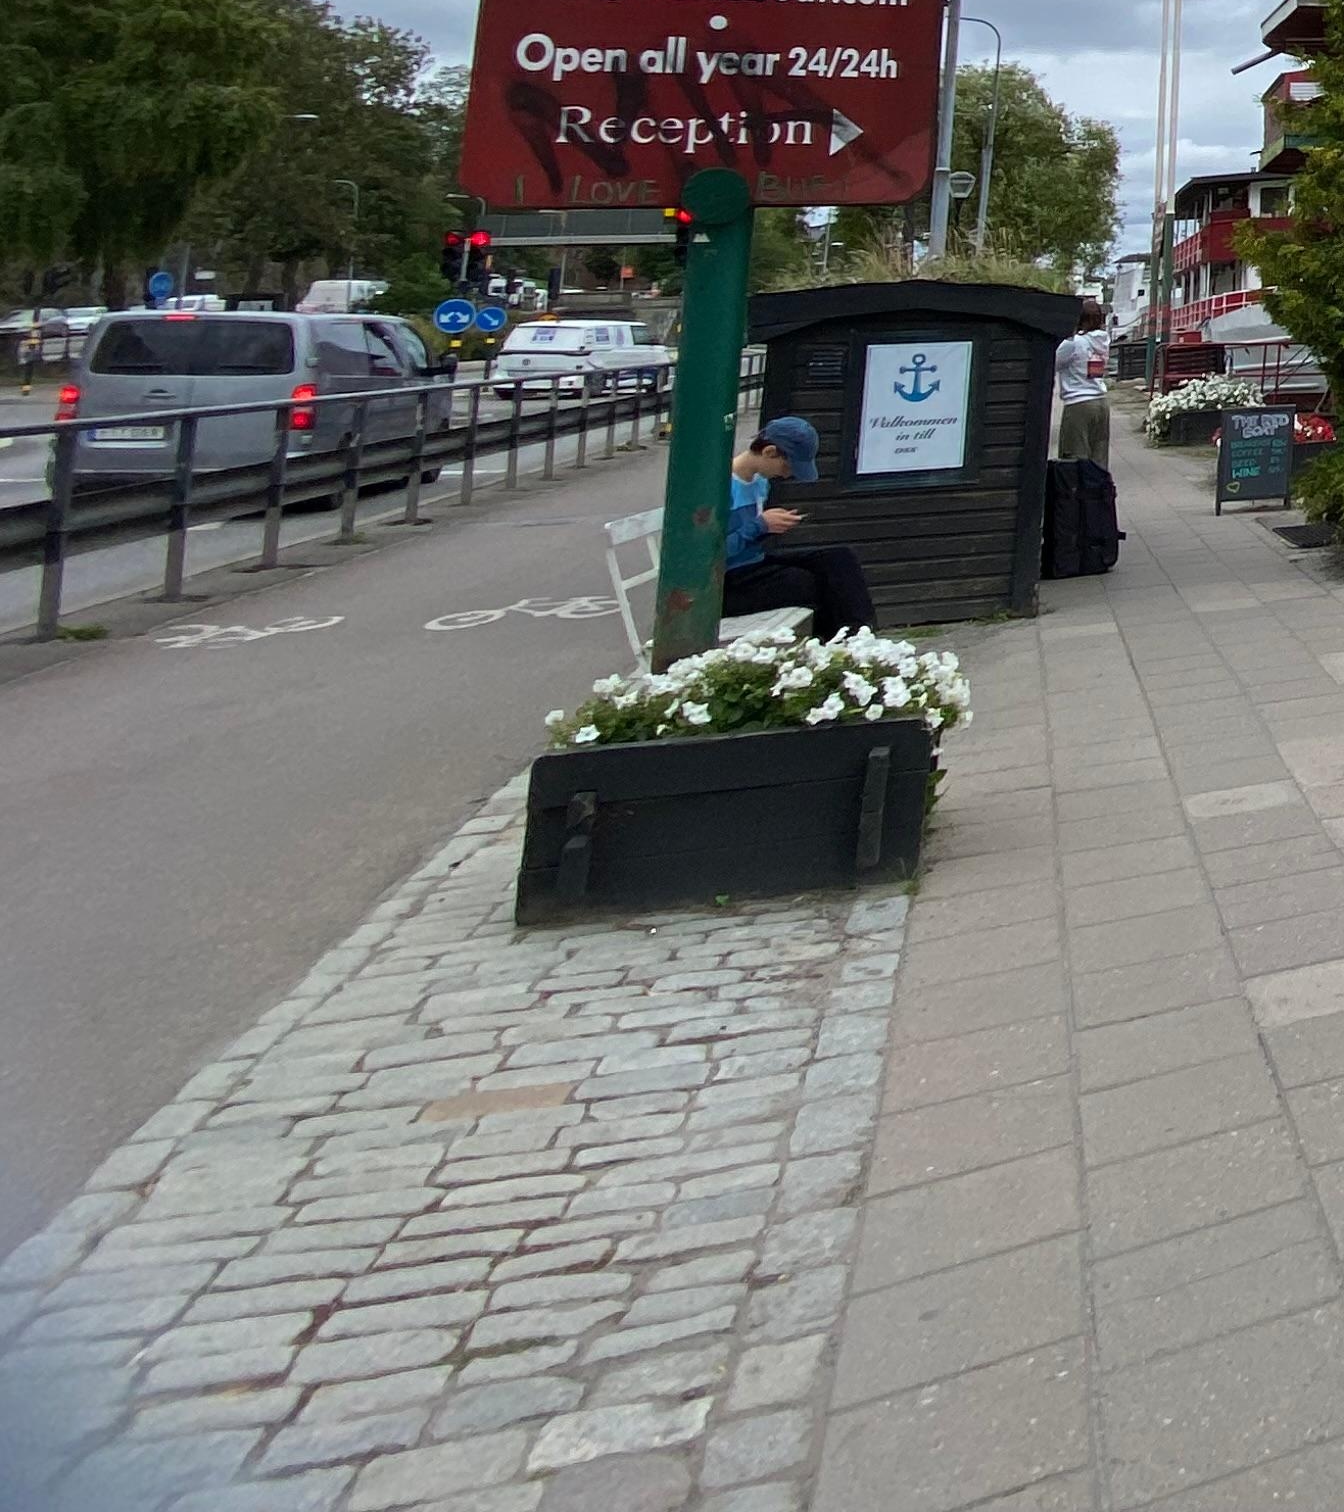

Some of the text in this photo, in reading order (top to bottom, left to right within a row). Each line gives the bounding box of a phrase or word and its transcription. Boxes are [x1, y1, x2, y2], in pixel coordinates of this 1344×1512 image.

[516, 33, 898, 84] Open all year 24/24h
[567, 174, 661, 205] LOVE
[896, 428, 936, 441] in till
[1232, 466, 1261, 479] WINE
